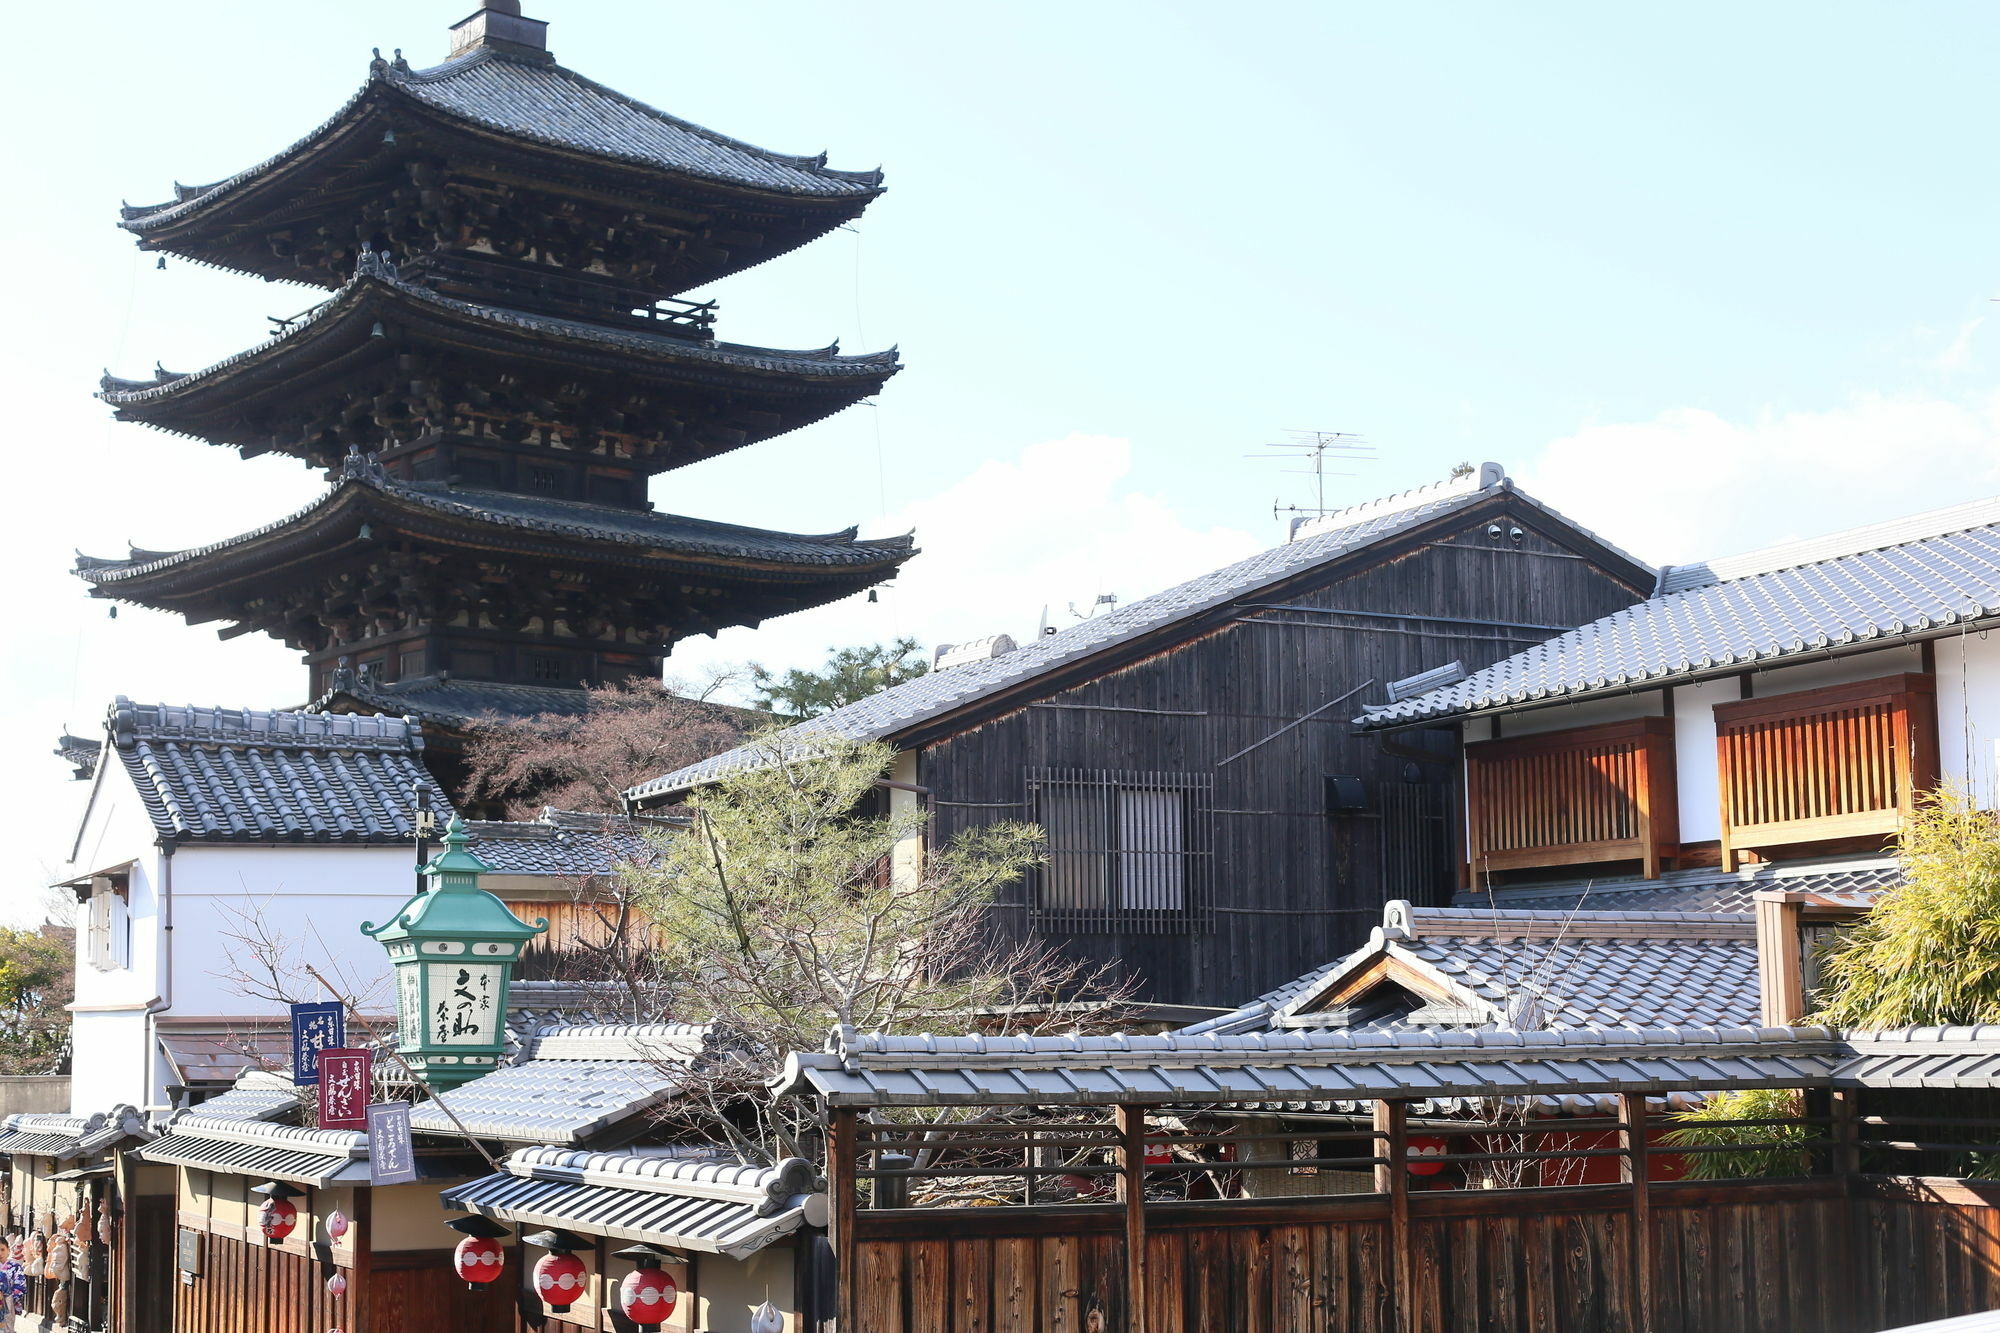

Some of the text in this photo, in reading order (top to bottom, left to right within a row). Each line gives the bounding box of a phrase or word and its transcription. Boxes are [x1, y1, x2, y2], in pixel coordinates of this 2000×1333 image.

[453, 968, 479, 1037] 文の助
[480, 973, 490, 1010] 本家
[437, 1000, 449, 1043] 茶屋
[387, 1115, 399, 1169] ところてん
